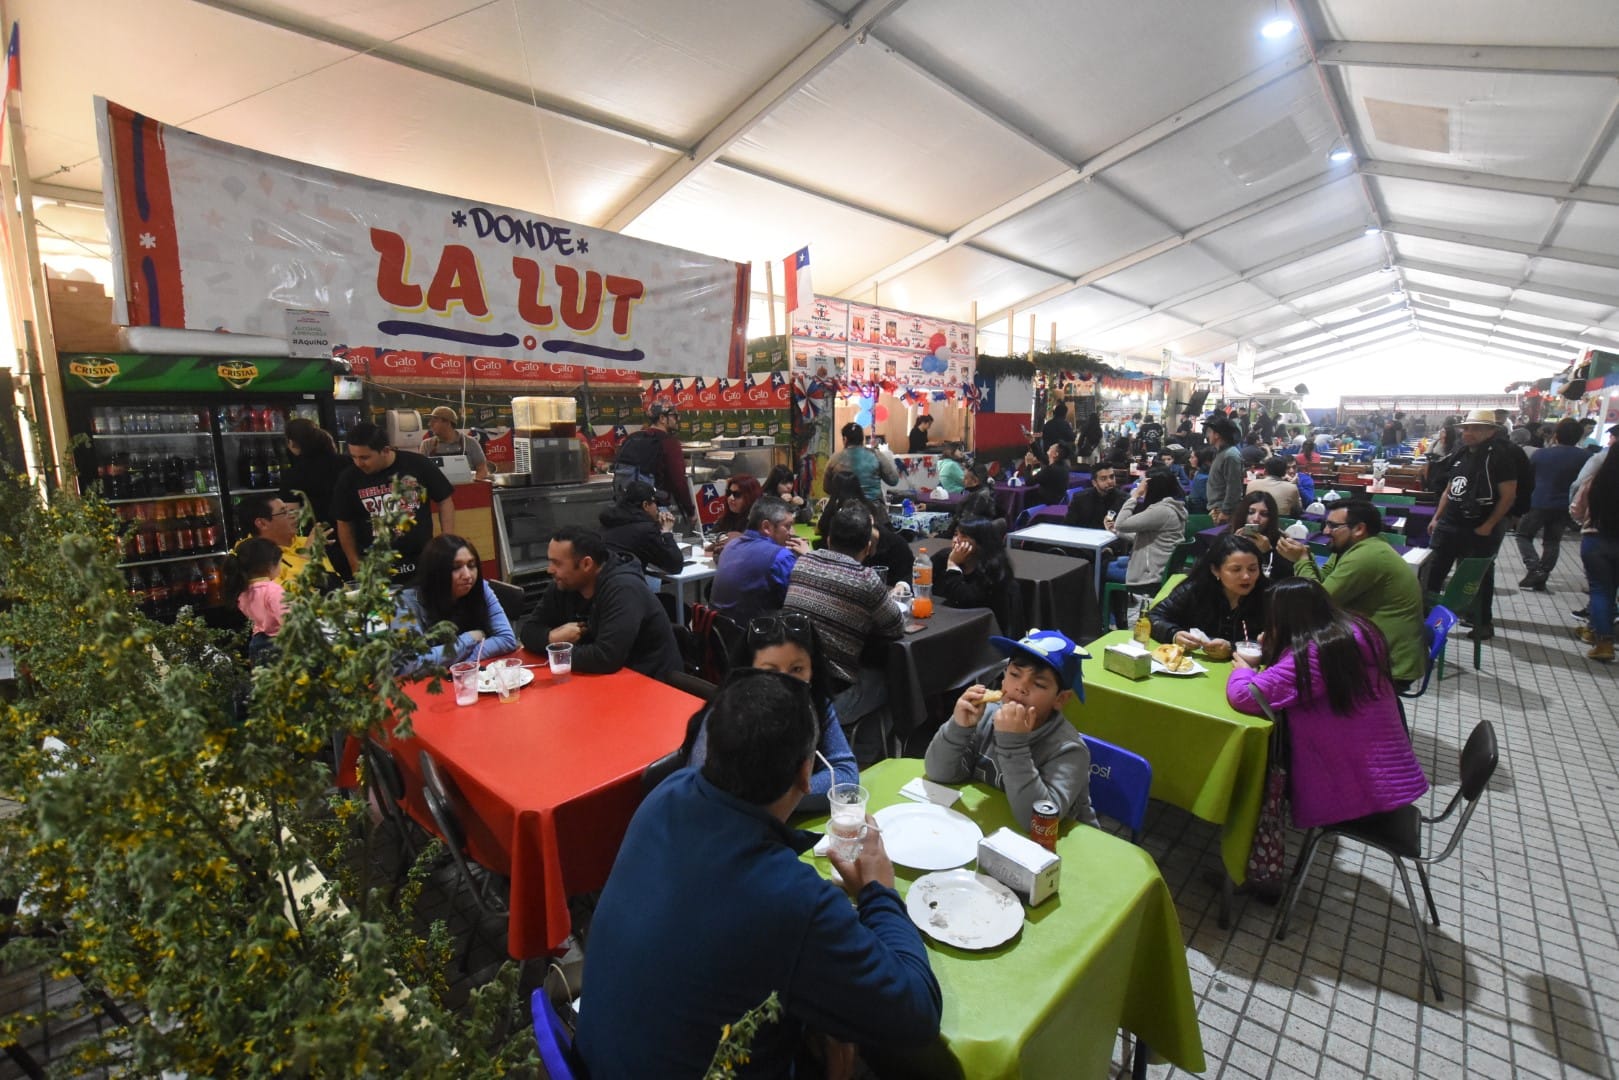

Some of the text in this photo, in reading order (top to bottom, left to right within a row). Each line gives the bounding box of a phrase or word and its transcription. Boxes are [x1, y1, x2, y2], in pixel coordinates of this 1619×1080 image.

[469, 207, 575, 256] DONDE
[369, 226, 646, 340] LA LUT
[383, 354, 417, 368] Gato
[430, 356, 461, 370] Gato
[473, 358, 502, 371] Gato
[513, 360, 540, 373] Gato
[74, 365, 117, 376] CRISTAL
[221, 367, 257, 377] CRISTAL
[550, 362, 574, 374] Gato
[677, 391, 694, 403] Gato
[699, 391, 717, 402] Gato
[723, 390, 741, 402] Gato
[749, 388, 769, 401] Gato
